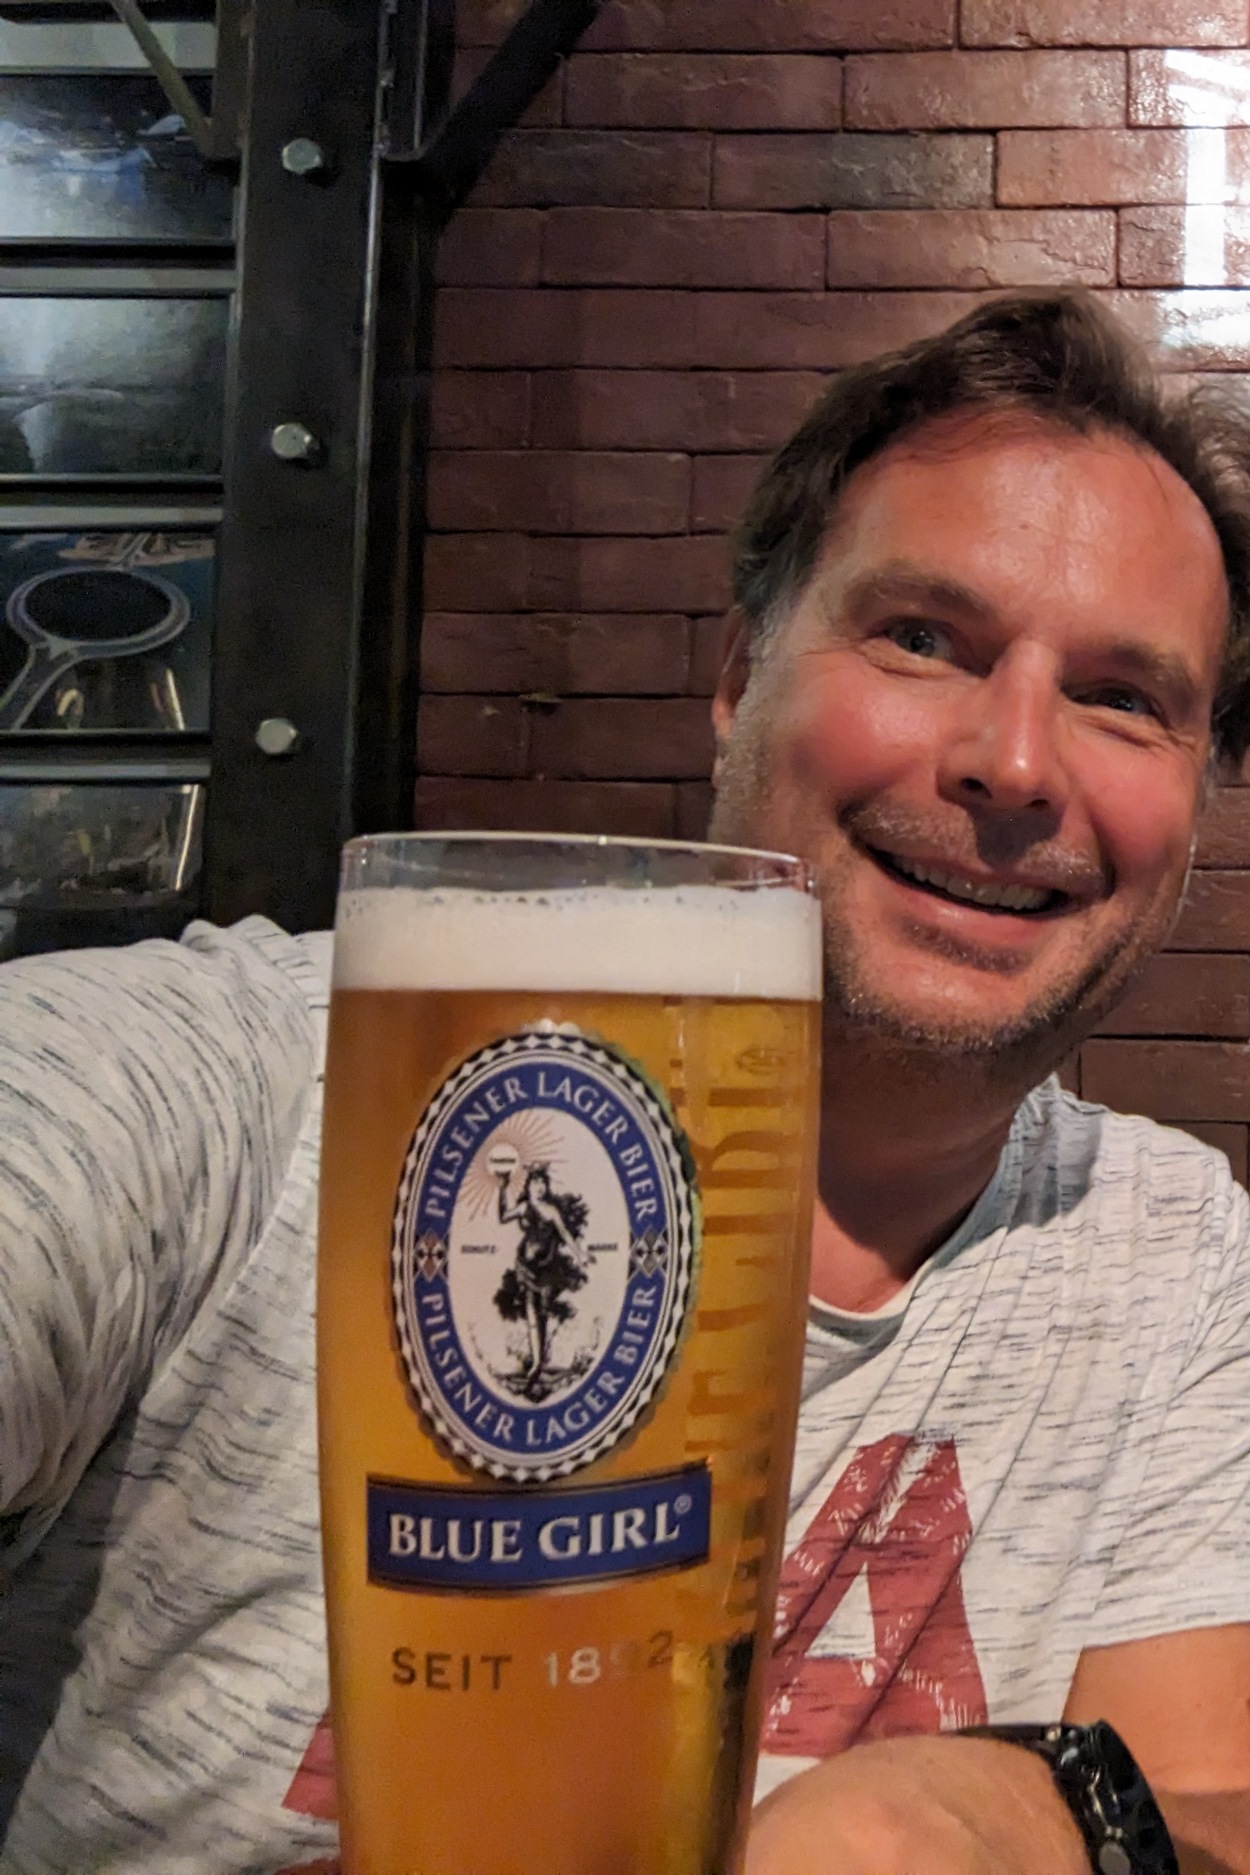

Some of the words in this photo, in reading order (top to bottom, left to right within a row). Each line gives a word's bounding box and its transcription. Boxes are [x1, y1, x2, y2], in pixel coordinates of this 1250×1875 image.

[427, 1080, 527, 1218] PILSENER
[538, 1072, 628, 1145] LAGER
[619, 1144, 656, 1220] BIER
[422, 1293, 514, 1444] PILSENER
[526, 1372, 625, 1447] LAGER
[615, 1286, 656, 1366] BIER
[388, 1514, 523, 1563] BLUE
[392, 1647, 512, 1691] SEIT
